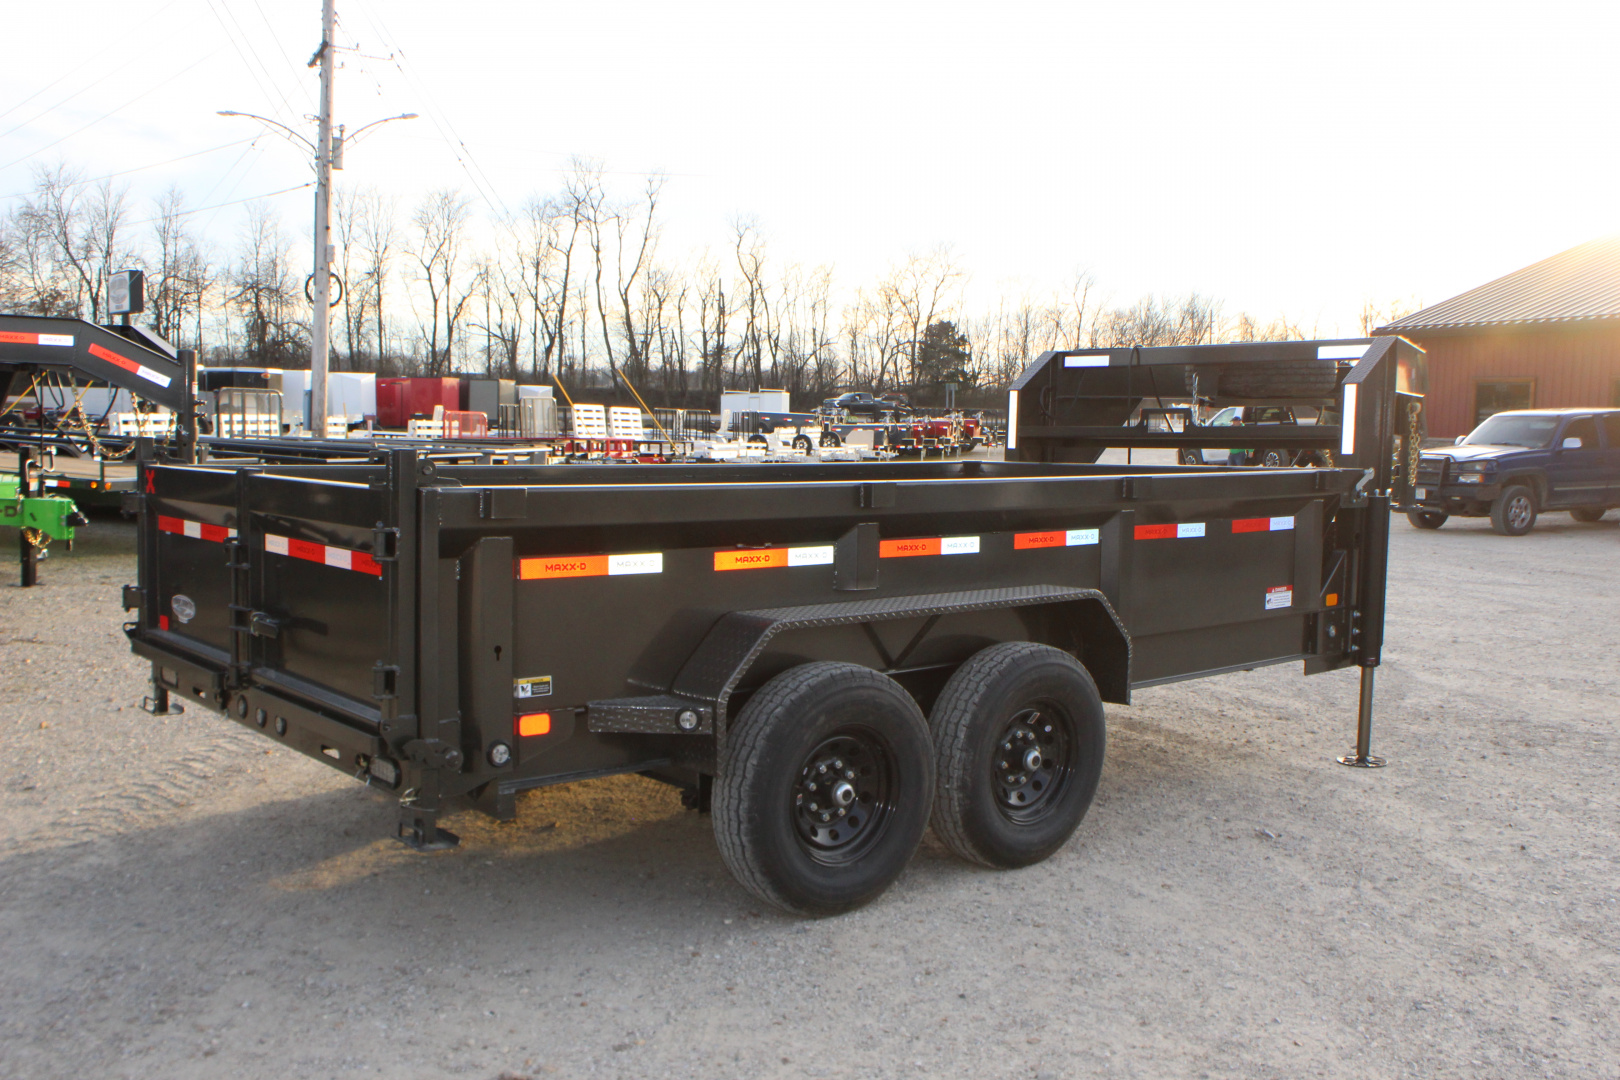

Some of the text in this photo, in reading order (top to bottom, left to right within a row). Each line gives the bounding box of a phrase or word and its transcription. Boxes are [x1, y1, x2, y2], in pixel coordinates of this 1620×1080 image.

[897, 544, 927, 552] MAXX-D
[735, 555, 771, 564] MAXX-D
[616, 560, 656, 568] MAXXD
